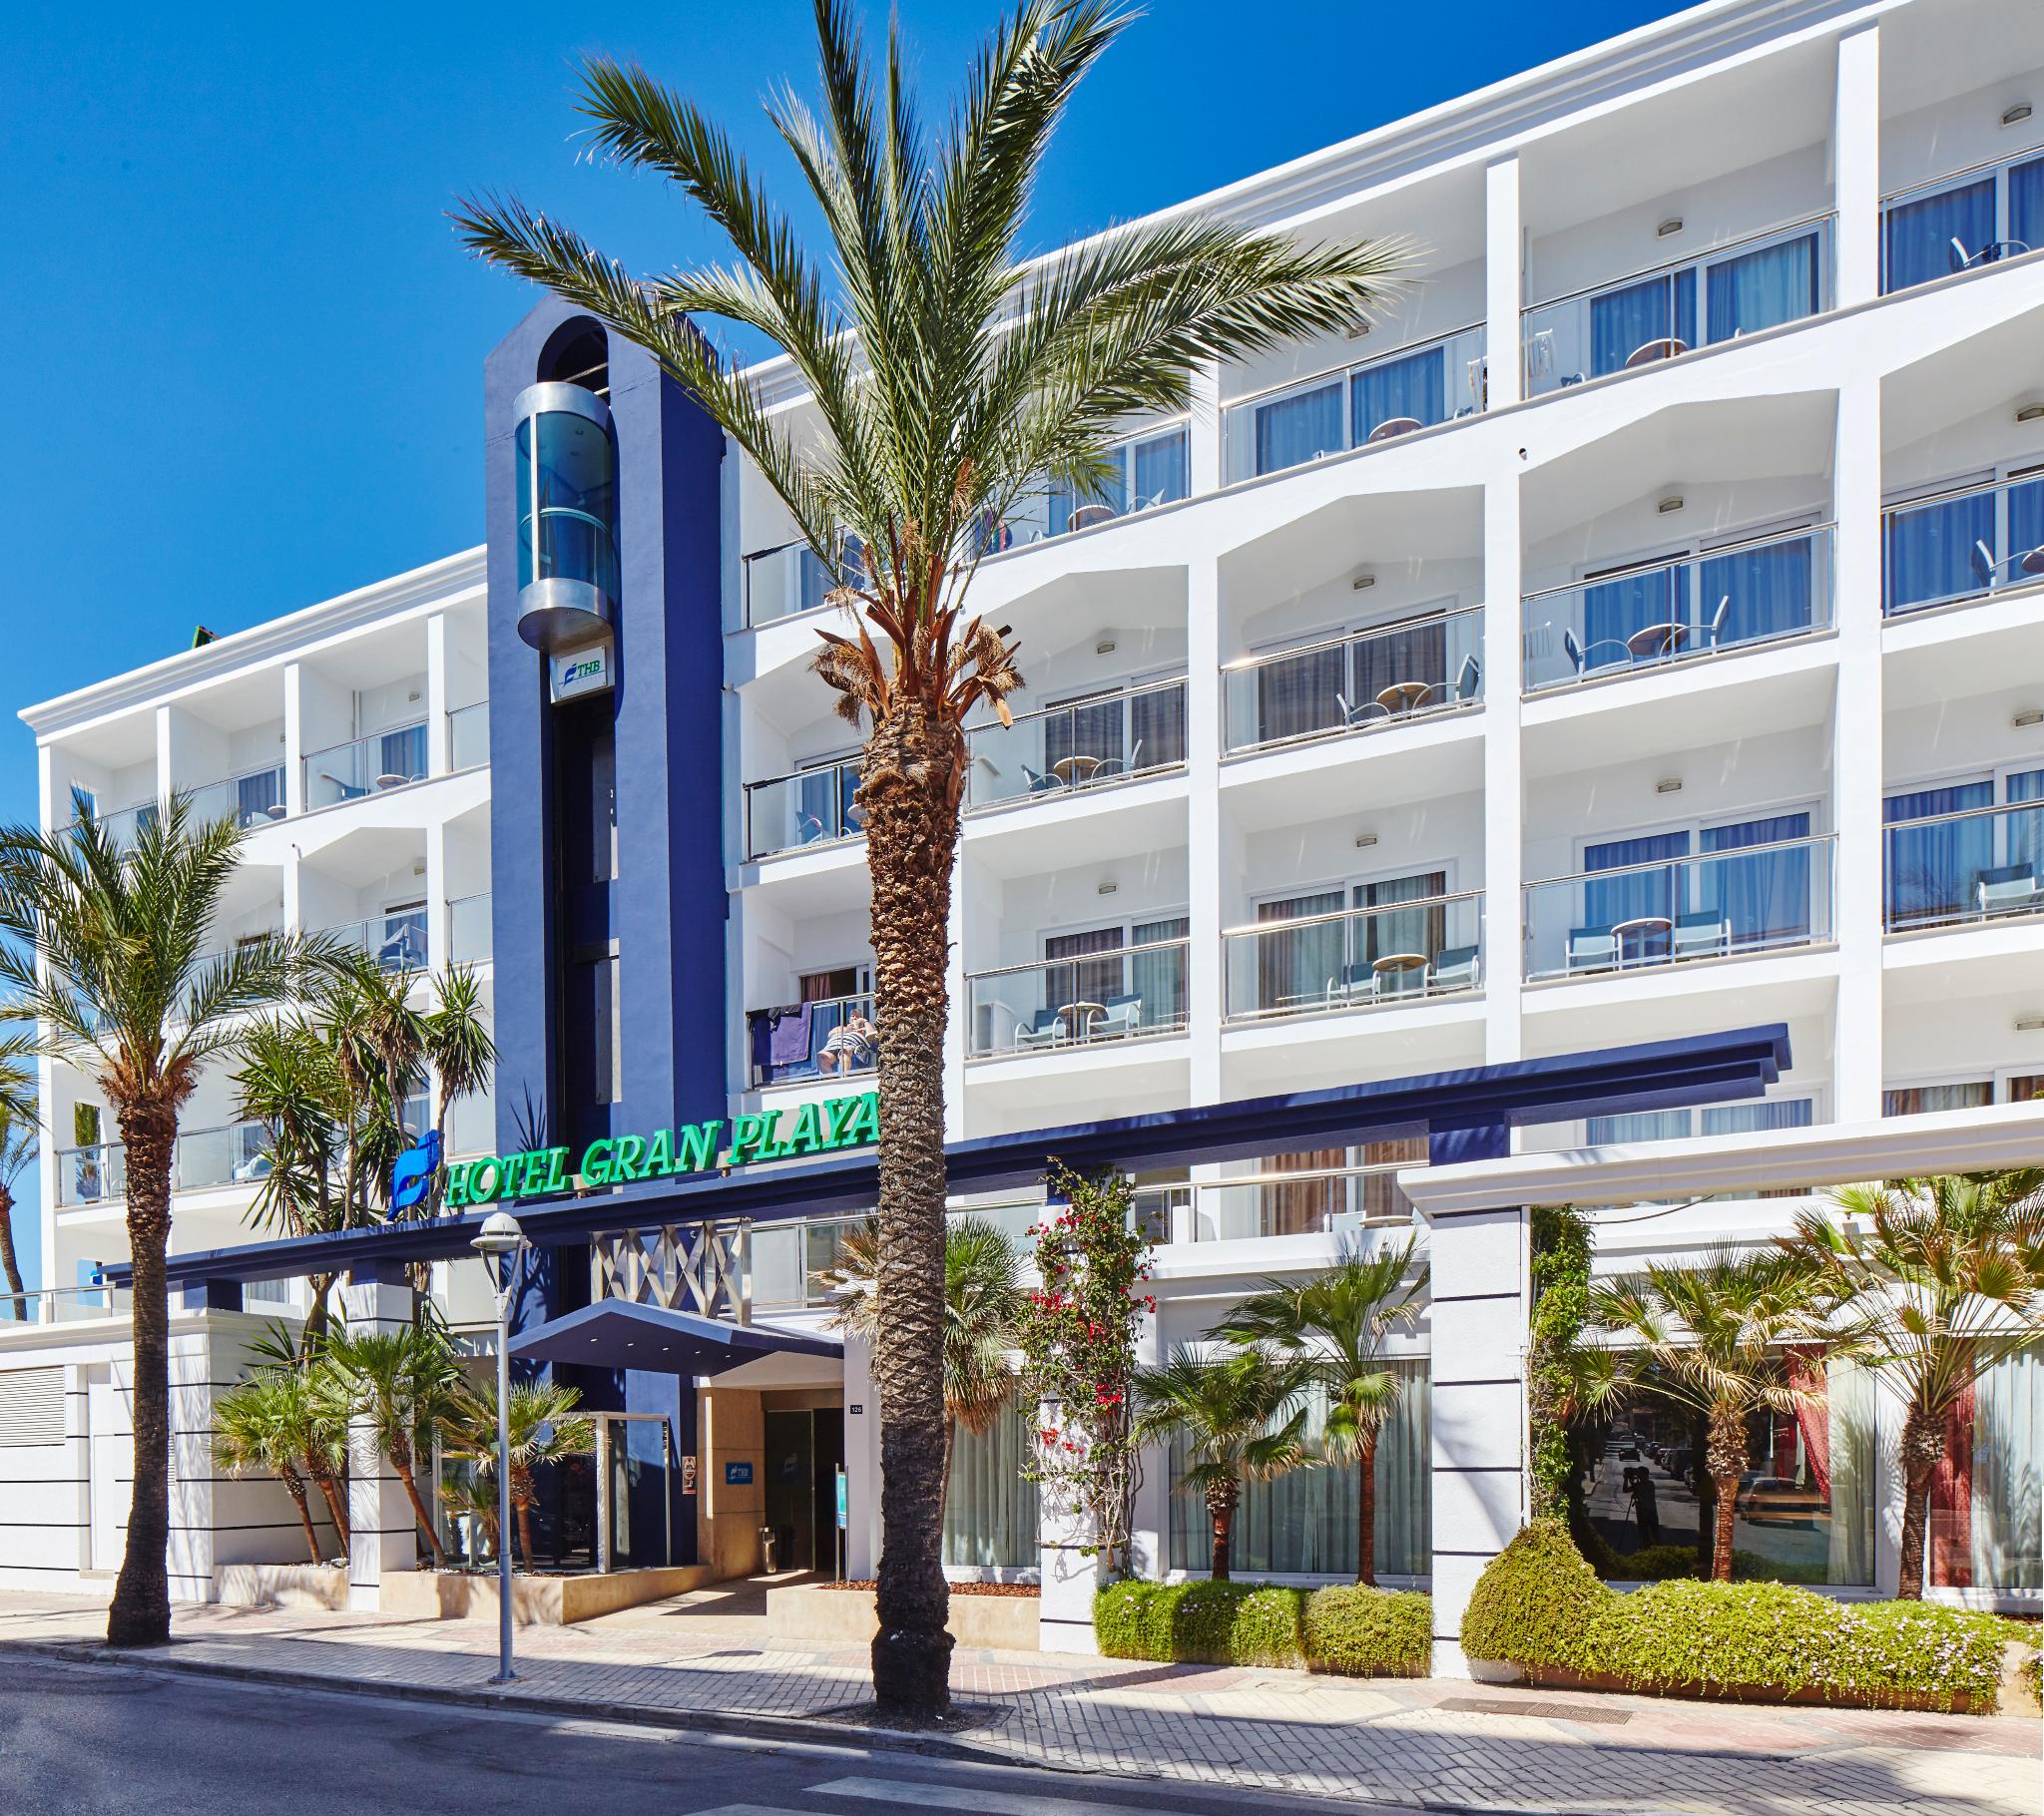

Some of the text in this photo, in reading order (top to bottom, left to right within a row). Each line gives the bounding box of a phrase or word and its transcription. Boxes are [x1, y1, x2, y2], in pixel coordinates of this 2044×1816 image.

[578, 661, 600, 677] THB
[446, 1092, 879, 1207] HOTEL GRAN PLAYA
